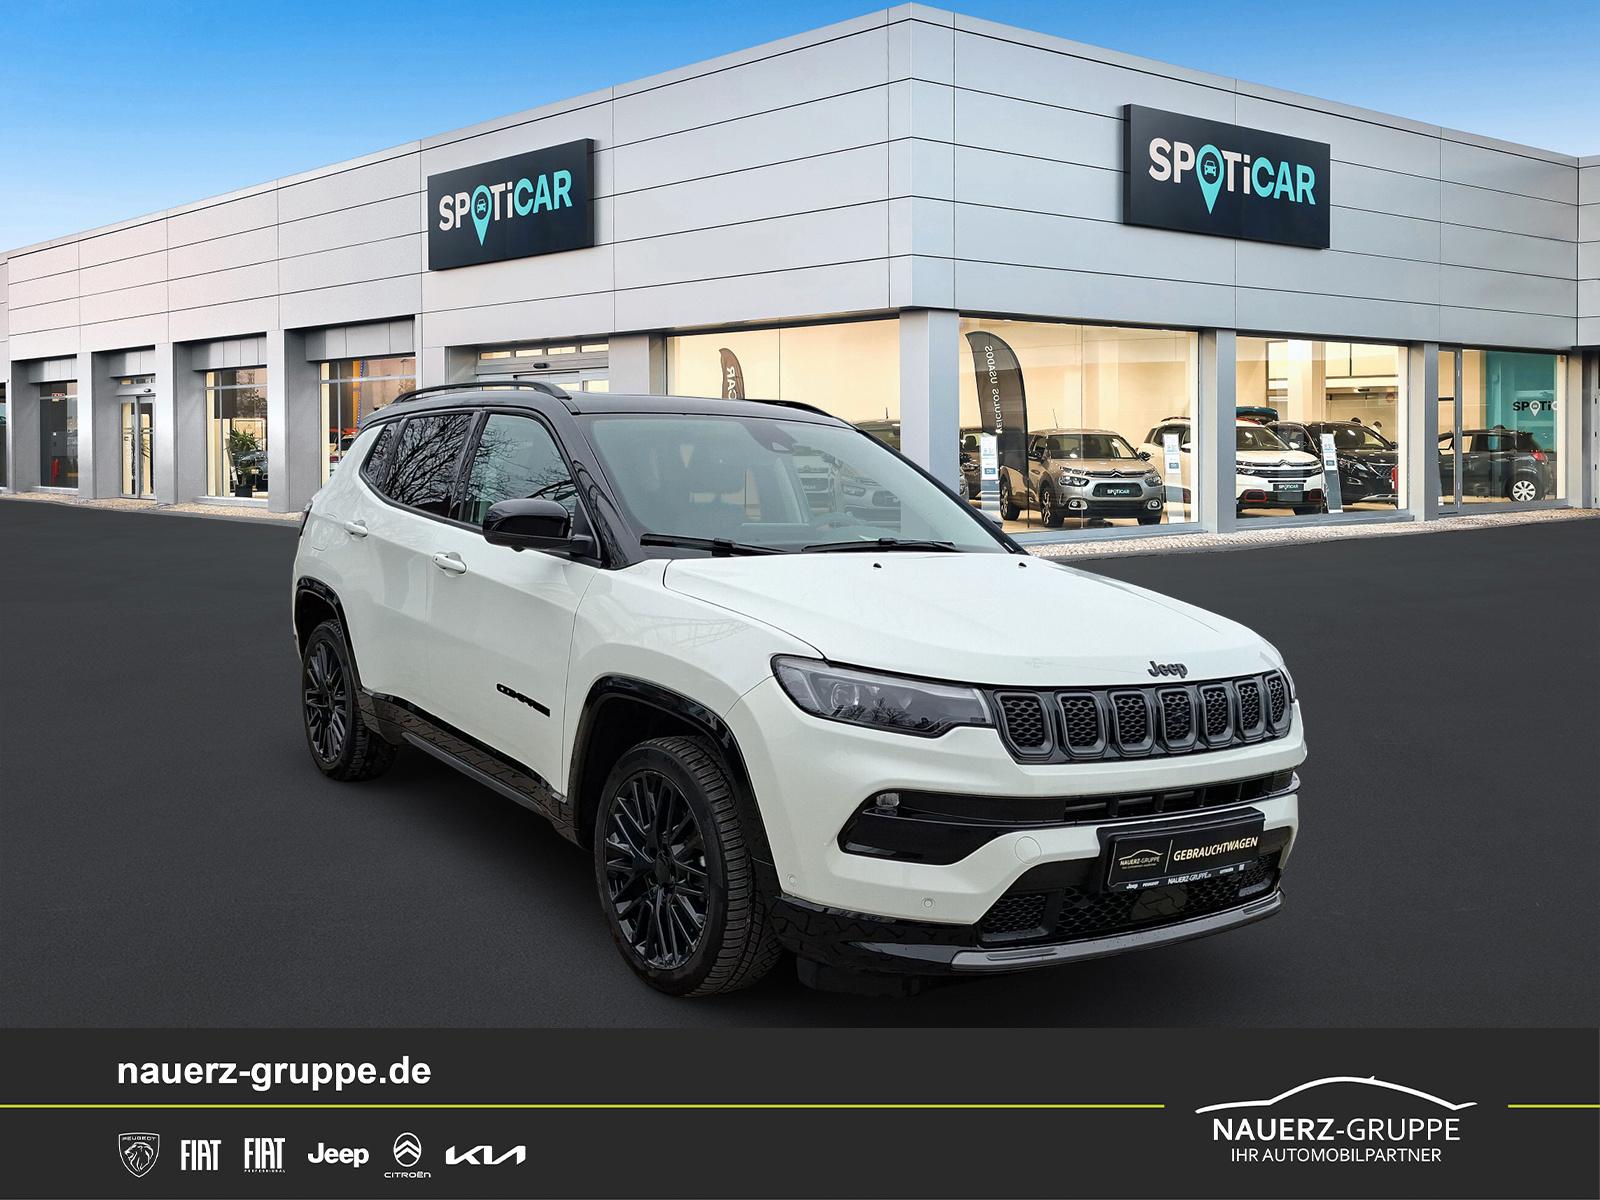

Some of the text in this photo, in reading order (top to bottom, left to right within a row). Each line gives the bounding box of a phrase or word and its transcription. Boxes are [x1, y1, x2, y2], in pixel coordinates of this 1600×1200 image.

[1147, 660, 1188, 679] Jeep
[1173, 836, 1259, 862] GEBRAUCHTWAGEN
[1119, 856, 1160, 866] NAUERZ-GRUPPE
